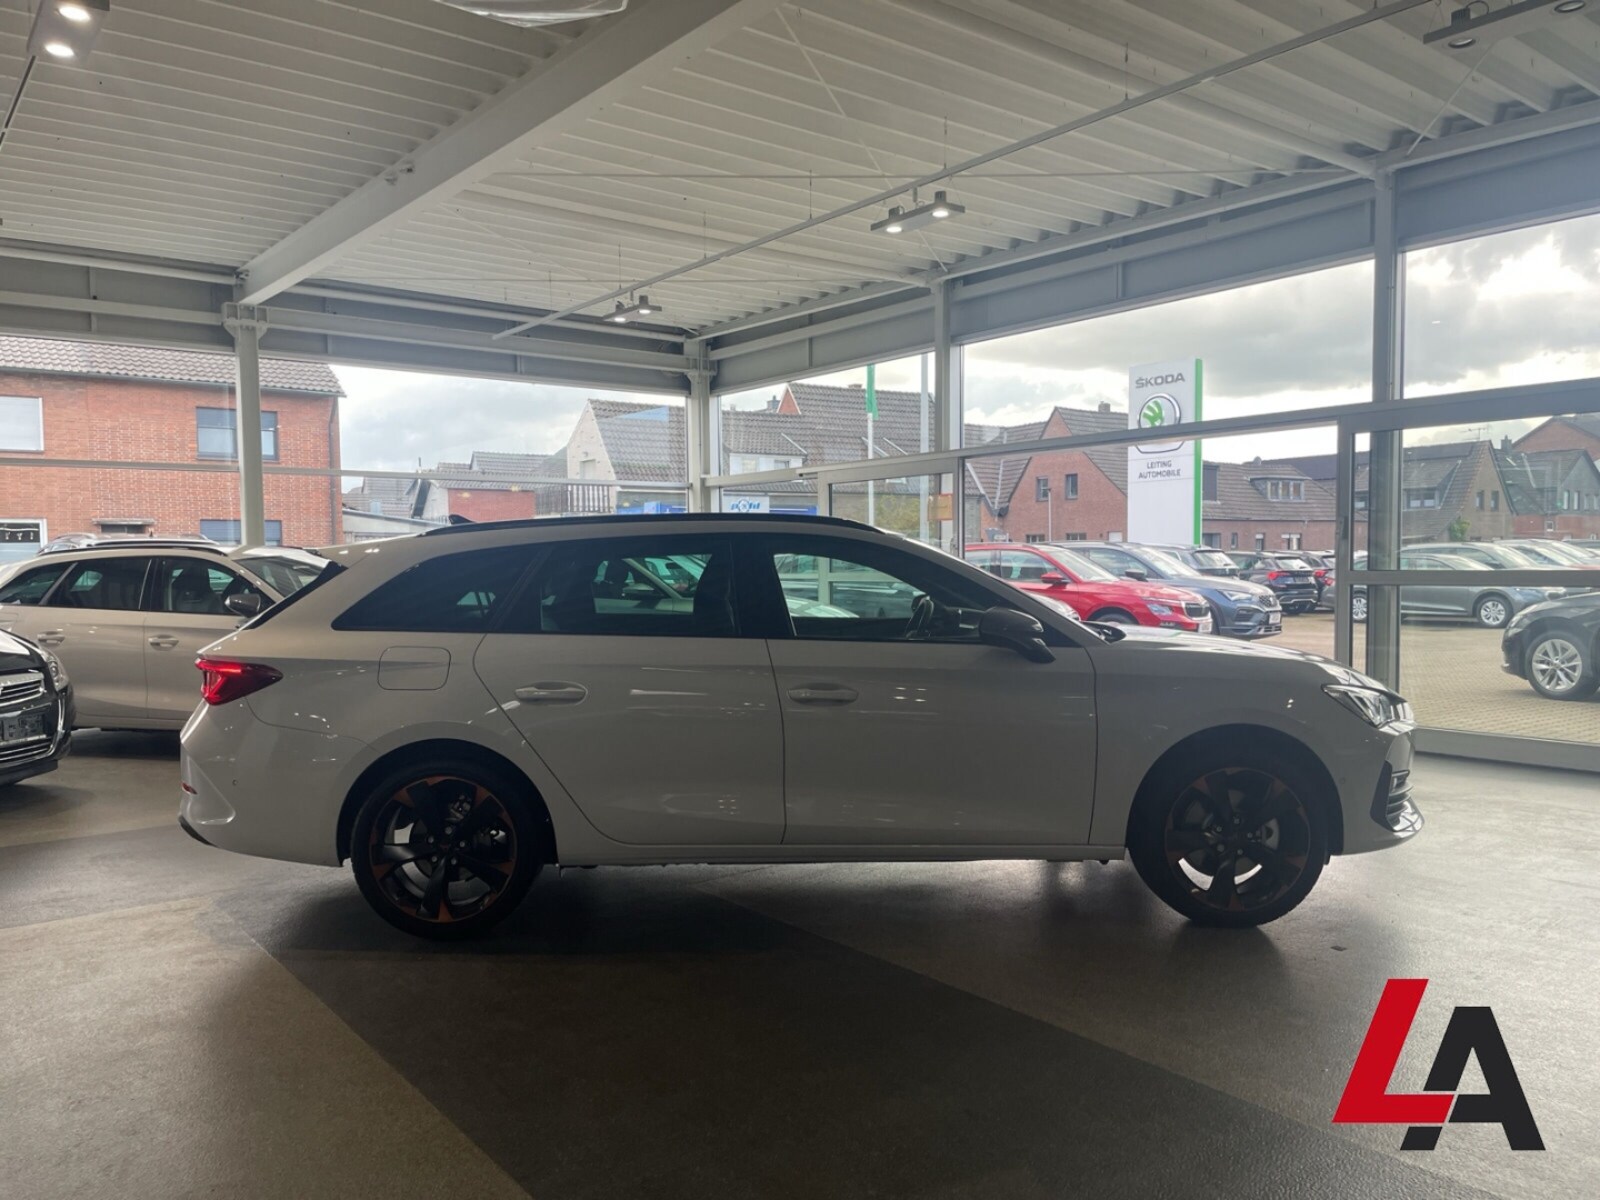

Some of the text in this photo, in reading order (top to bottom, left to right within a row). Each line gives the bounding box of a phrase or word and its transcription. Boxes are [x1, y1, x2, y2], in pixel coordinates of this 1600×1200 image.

[1135, 373, 1185, 388] ŠKODA
[1147, 460, 1172, 469] LEITING
[1138, 469, 1181, 479] AUTOMOBILE
